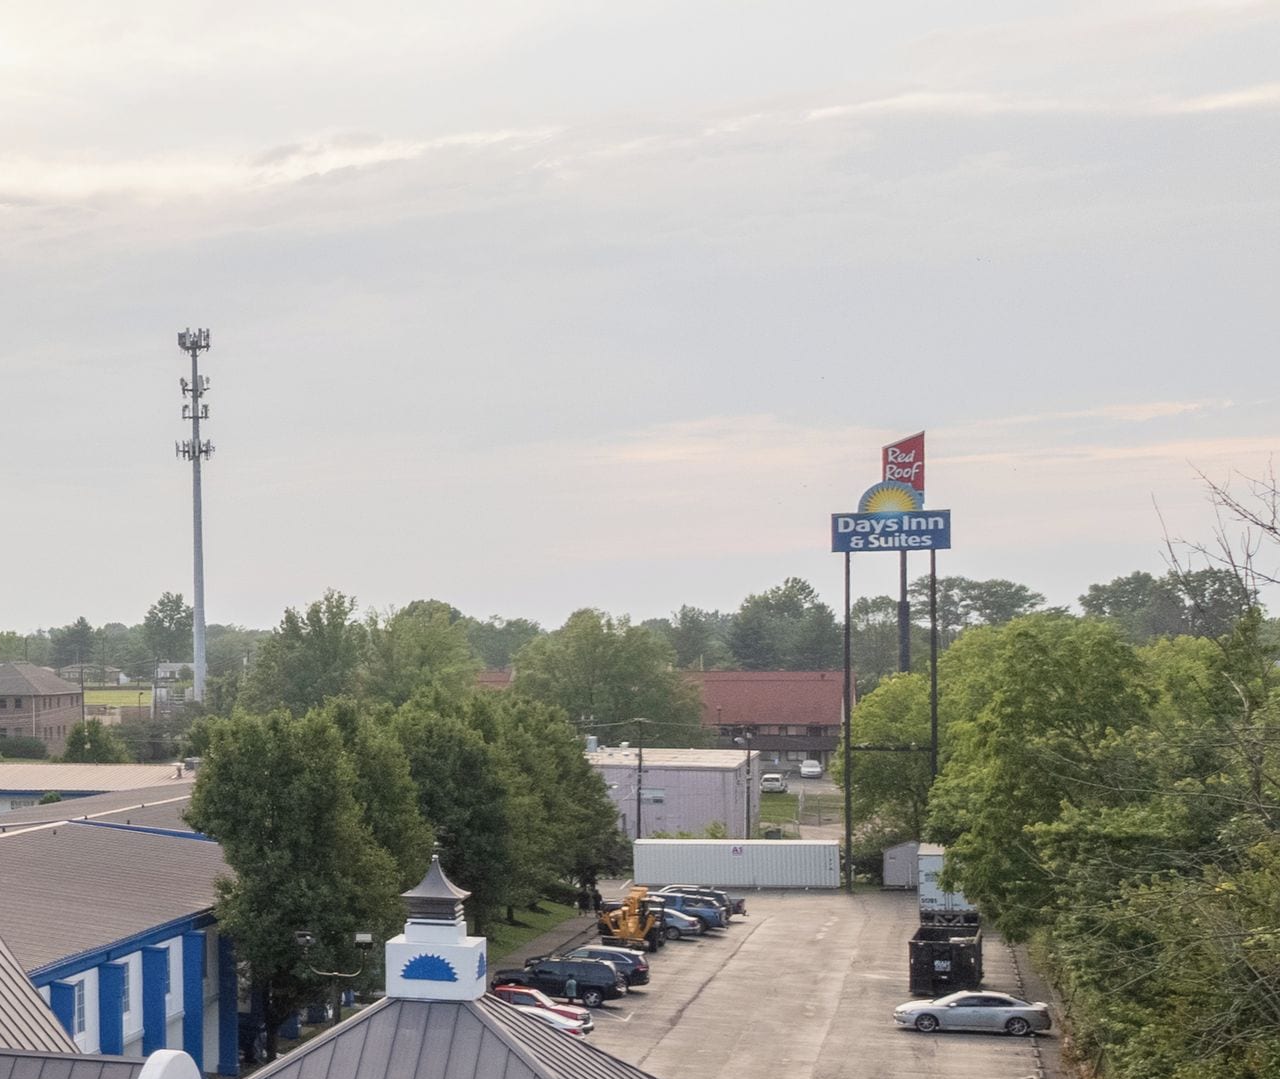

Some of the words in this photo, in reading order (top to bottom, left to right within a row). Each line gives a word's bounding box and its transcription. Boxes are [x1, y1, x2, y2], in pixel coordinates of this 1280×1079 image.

[888, 447, 915, 463] Red
[886, 461, 922, 481] Roof
[837, 517, 899, 534] Days
[902, 515, 944, 531] Inn
[850, 535, 865, 549] &
[868, 532, 933, 548] Suites
